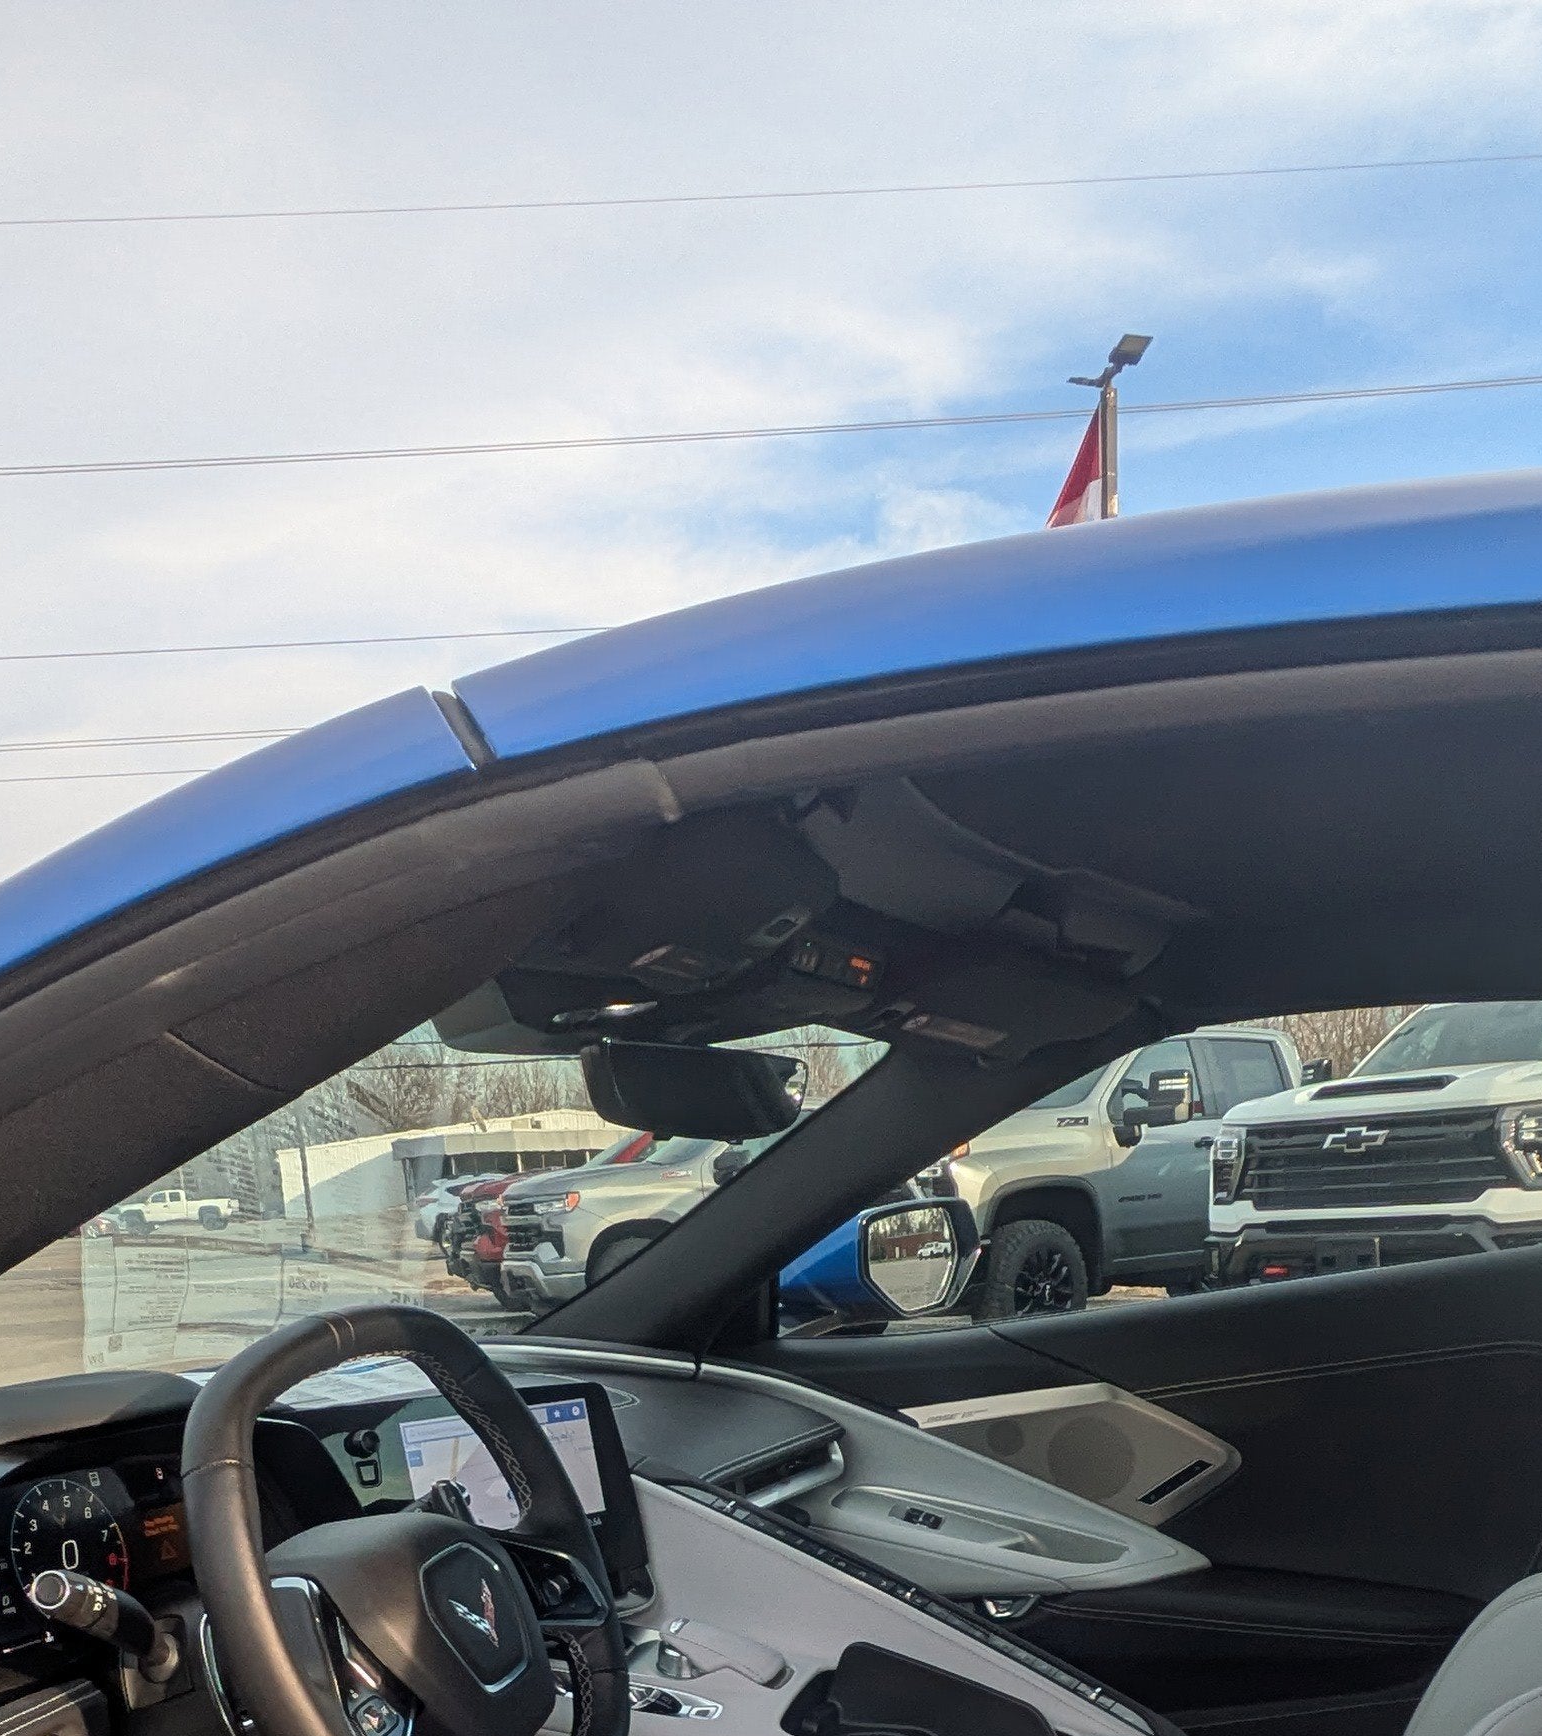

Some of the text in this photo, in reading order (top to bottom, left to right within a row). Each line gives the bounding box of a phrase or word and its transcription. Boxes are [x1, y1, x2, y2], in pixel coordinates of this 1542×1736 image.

[42, 1501, 50, 1512] 4
[63, 1495, 71, 1508] 5
[84, 1507, 92, 1518] 6
[29, 1519, 38, 1532] 3
[101, 1529, 109, 1542] 7
[24, 1542, 32, 1554] 2
[61, 1539, 79, 1570] 0
